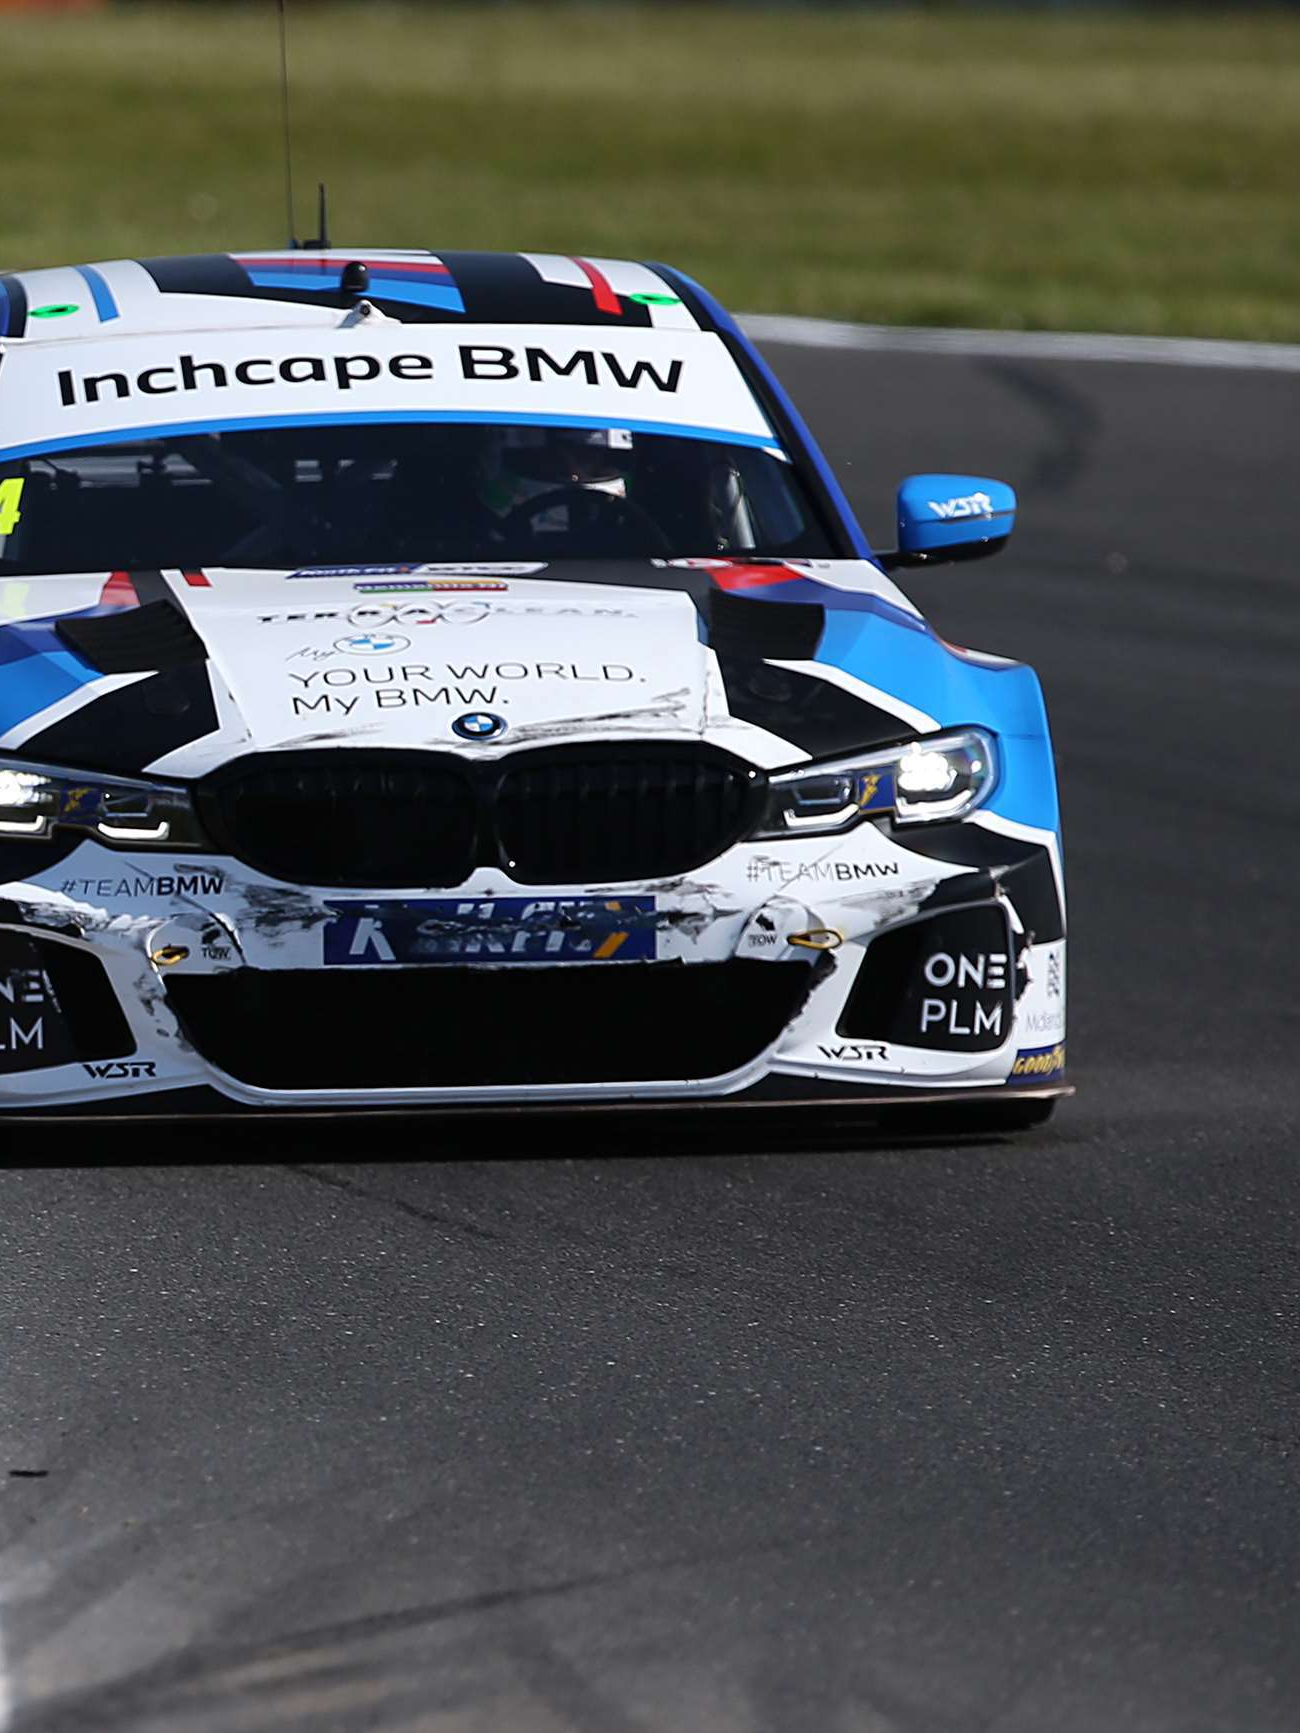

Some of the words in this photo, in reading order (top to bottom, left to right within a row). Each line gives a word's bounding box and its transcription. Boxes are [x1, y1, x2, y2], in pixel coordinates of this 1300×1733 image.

[56, 351, 434, 406] Inchcape
[457, 344, 685, 393] BMW
[927, 492, 994, 518] WSR
[288, 664, 435, 690] YOUR
[447, 662, 646, 683] WORLD.
[291, 694, 360, 715] My
[376, 684, 510, 711] BMW.
[746, 860, 900, 883] #TEAMBMW
[60, 875, 225, 897] #TEAMBMW
[924, 952, 1009, 990] ONE
[920, 998, 1003, 1037] PLM
[817, 1045, 891, 1061] WSR
[81, 1062, 157, 1079] WSR
